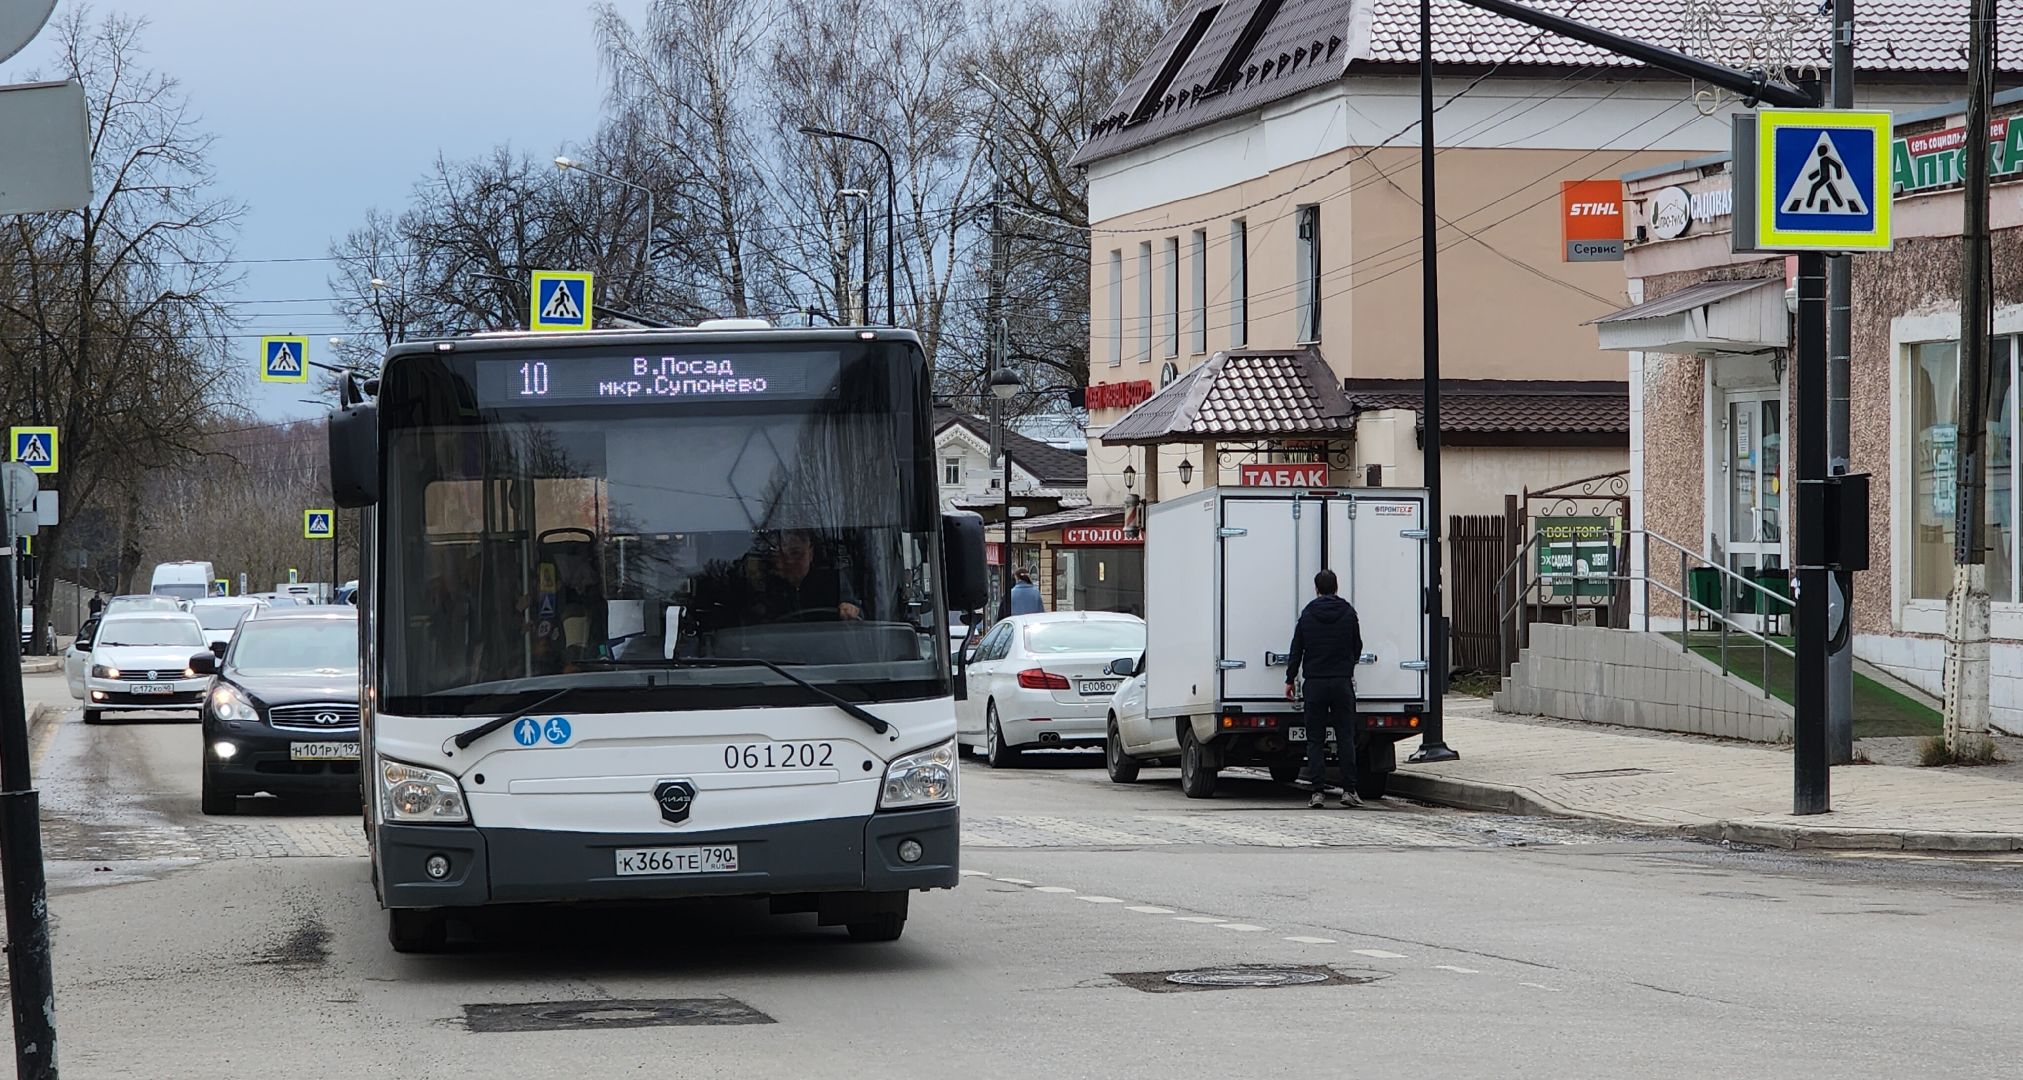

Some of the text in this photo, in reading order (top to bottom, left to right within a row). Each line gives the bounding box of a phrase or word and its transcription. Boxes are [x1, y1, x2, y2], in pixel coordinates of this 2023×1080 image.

[1911, 140, 1928, 153] сеть
[1570, 202, 1619, 216] STIHL
[1574, 243, 1617, 256] Сервис
[633, 357, 733, 376] В.Посад
[520, 362, 548, 395] 10
[600, 375, 767, 397] мкр.Супонево
[1245, 470, 1326, 487] ТАБАК
[1551, 554, 1573, 569] САДОВА
[295, 744, 339, 756] Н101РУ
[724, 743, 834, 769] 061202
[623, 848, 733, 872] К366ТЕ 790
